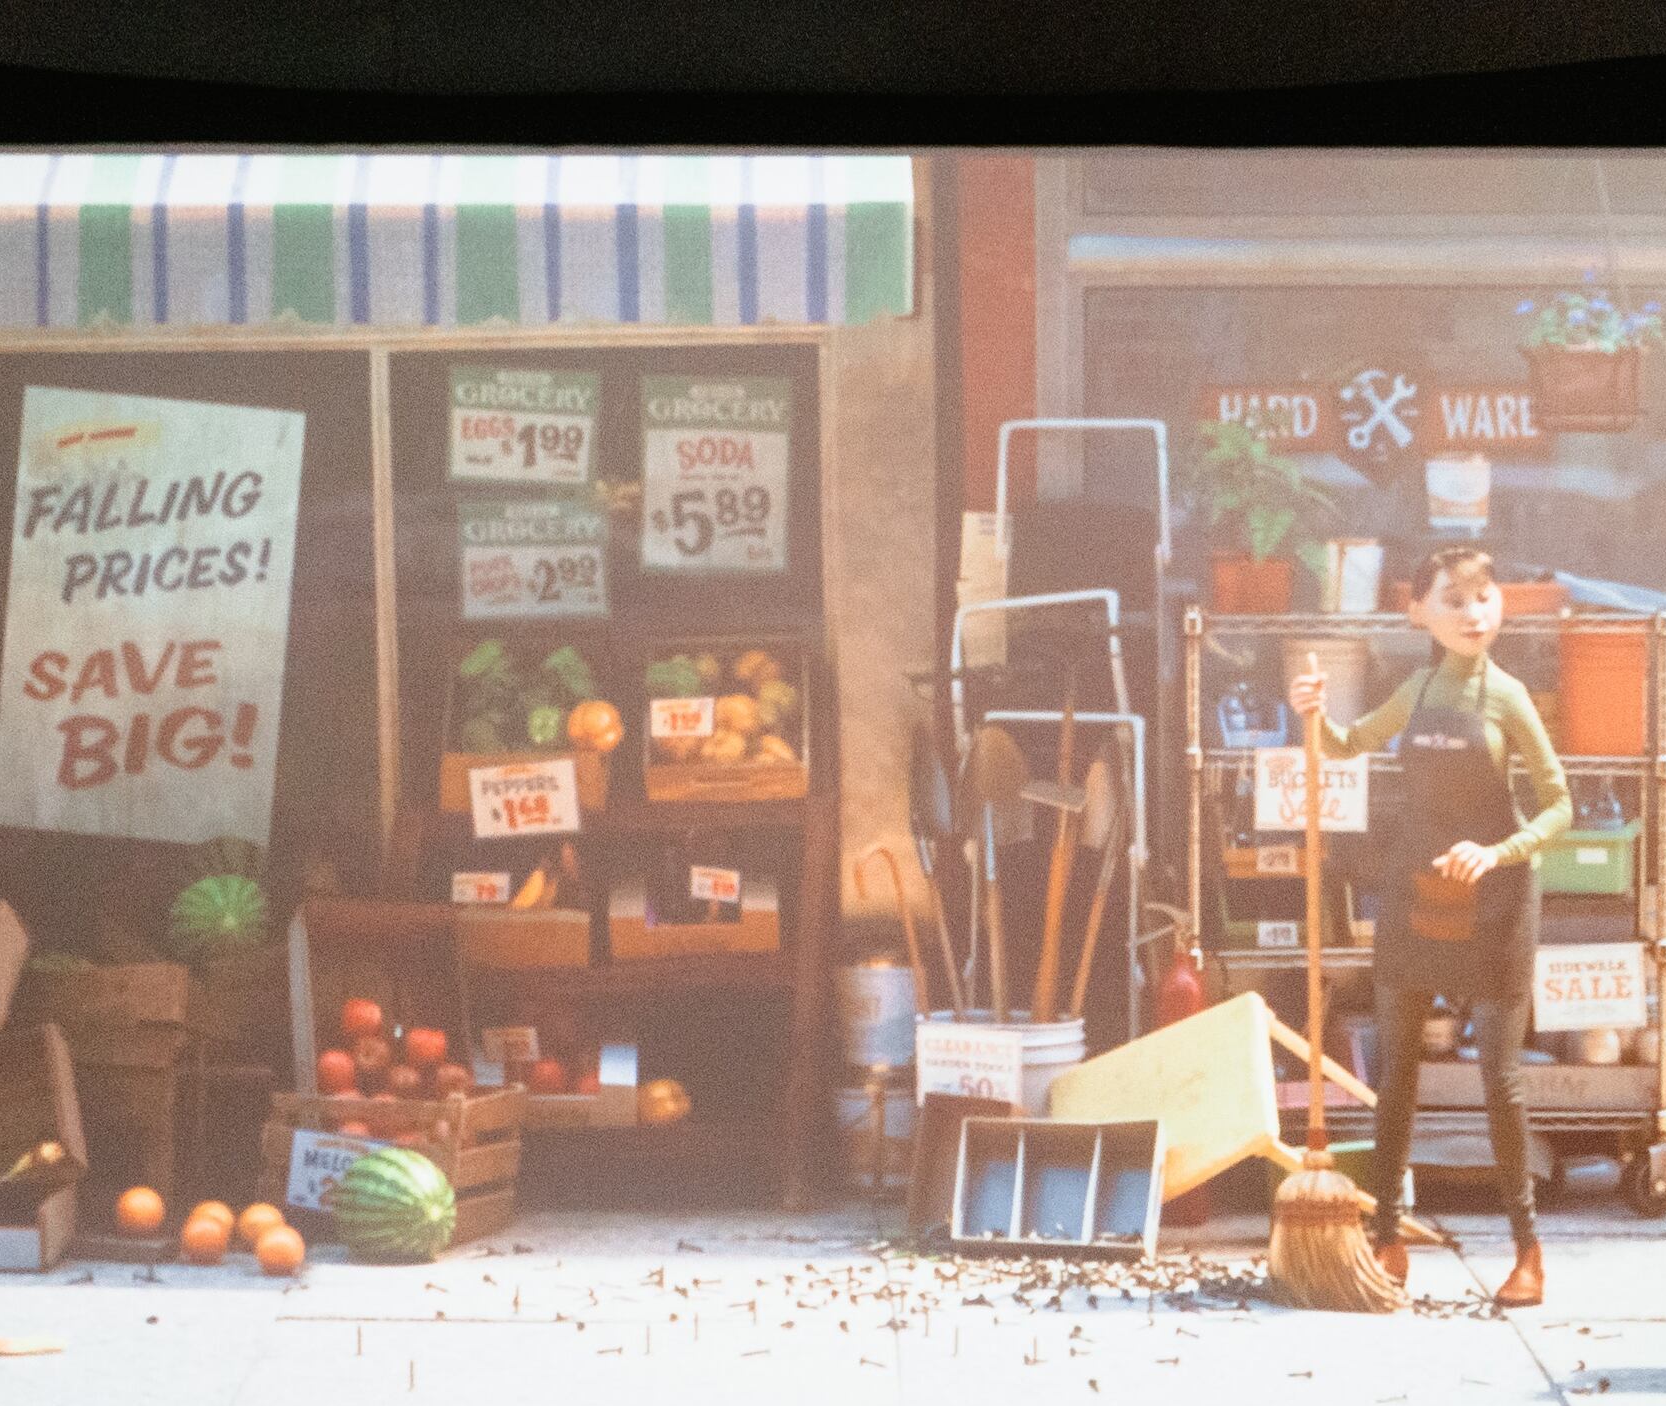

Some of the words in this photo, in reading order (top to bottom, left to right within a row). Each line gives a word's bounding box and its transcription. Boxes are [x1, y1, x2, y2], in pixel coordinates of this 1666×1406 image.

[454, 382, 593, 411] GROCERY
[647, 397, 785, 423] GROCERY
[1439, 392, 1539, 441] WARE
[675, 435, 755, 471] SODA
[22, 470, 263, 539] FALLING
[60, 541, 274, 602] PRICES!
[22, 639, 222, 704] SAVE
[55, 702, 259, 791] BIG!
[1267, 770, 1358, 791] BUCETS
[1543, 975, 1634, 1003] SALE
